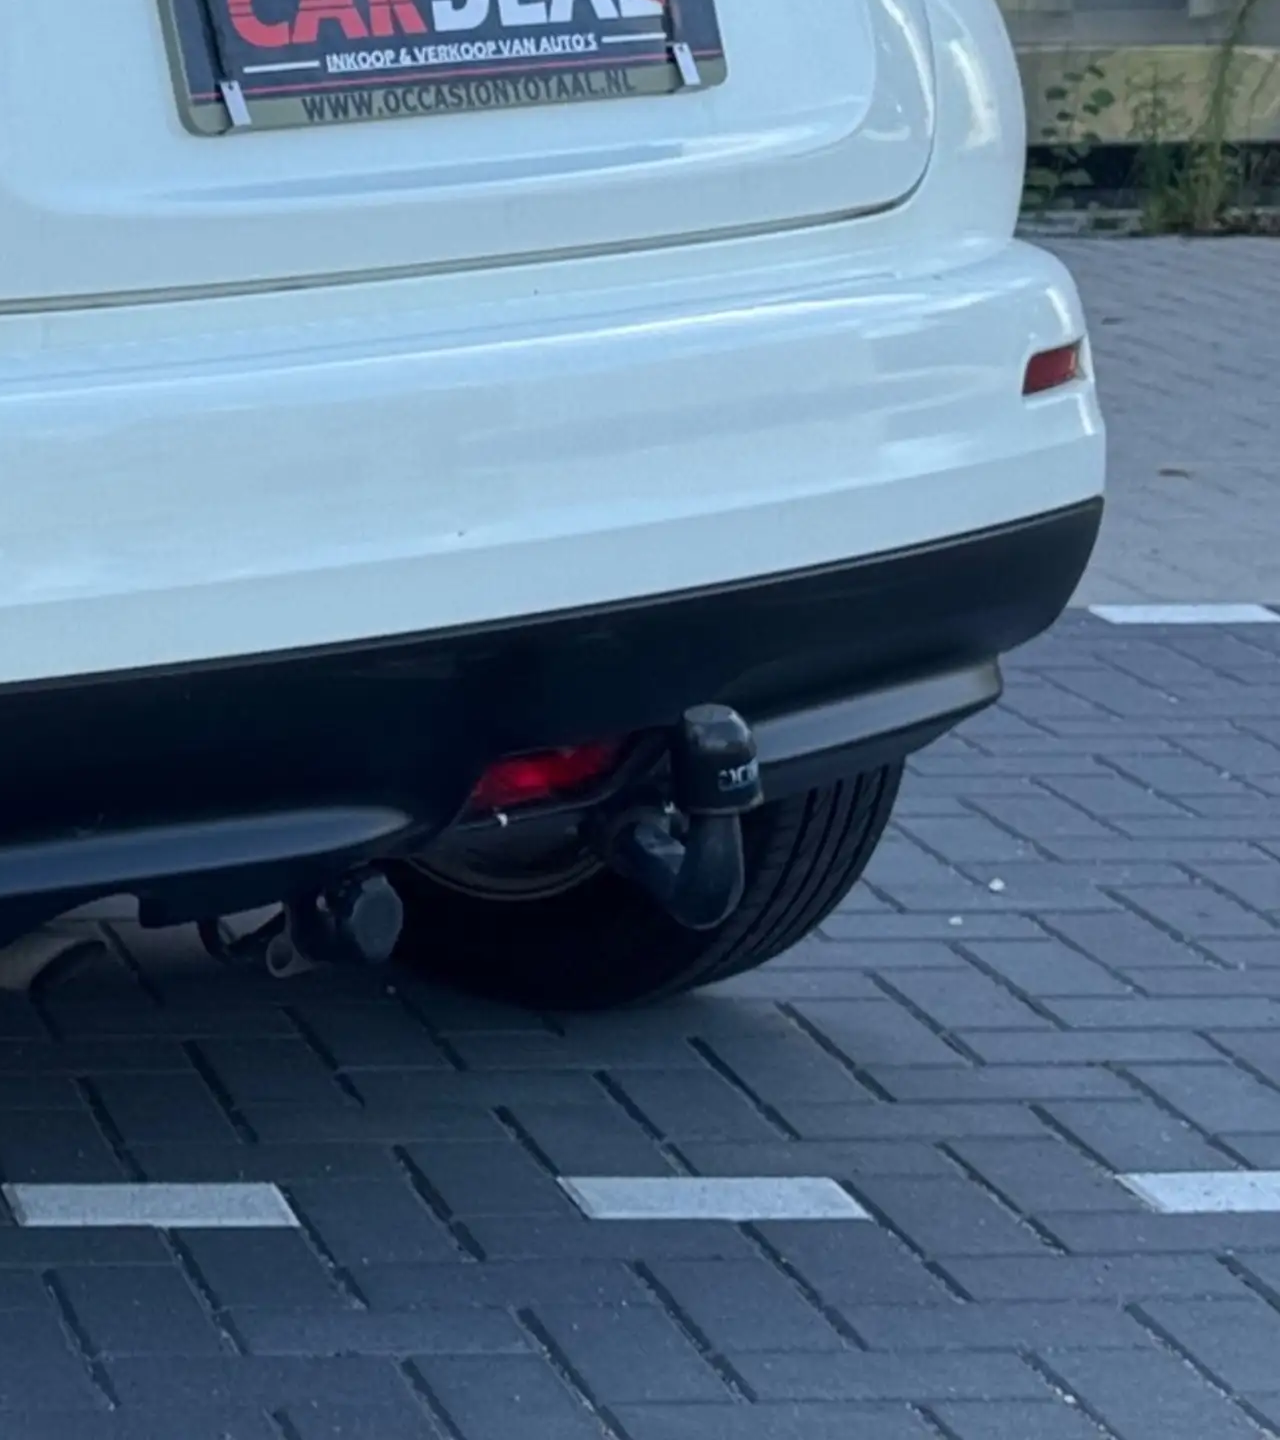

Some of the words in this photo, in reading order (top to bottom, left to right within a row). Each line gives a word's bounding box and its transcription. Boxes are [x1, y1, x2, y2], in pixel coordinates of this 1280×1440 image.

[325, 49, 396, 73] INKOOP
[399, 47, 412, 66] &
[412, 40, 499, 64] VERKOOP
[498, 36, 536, 58] VAN
[539, 32, 599, 55] AUTO'S
